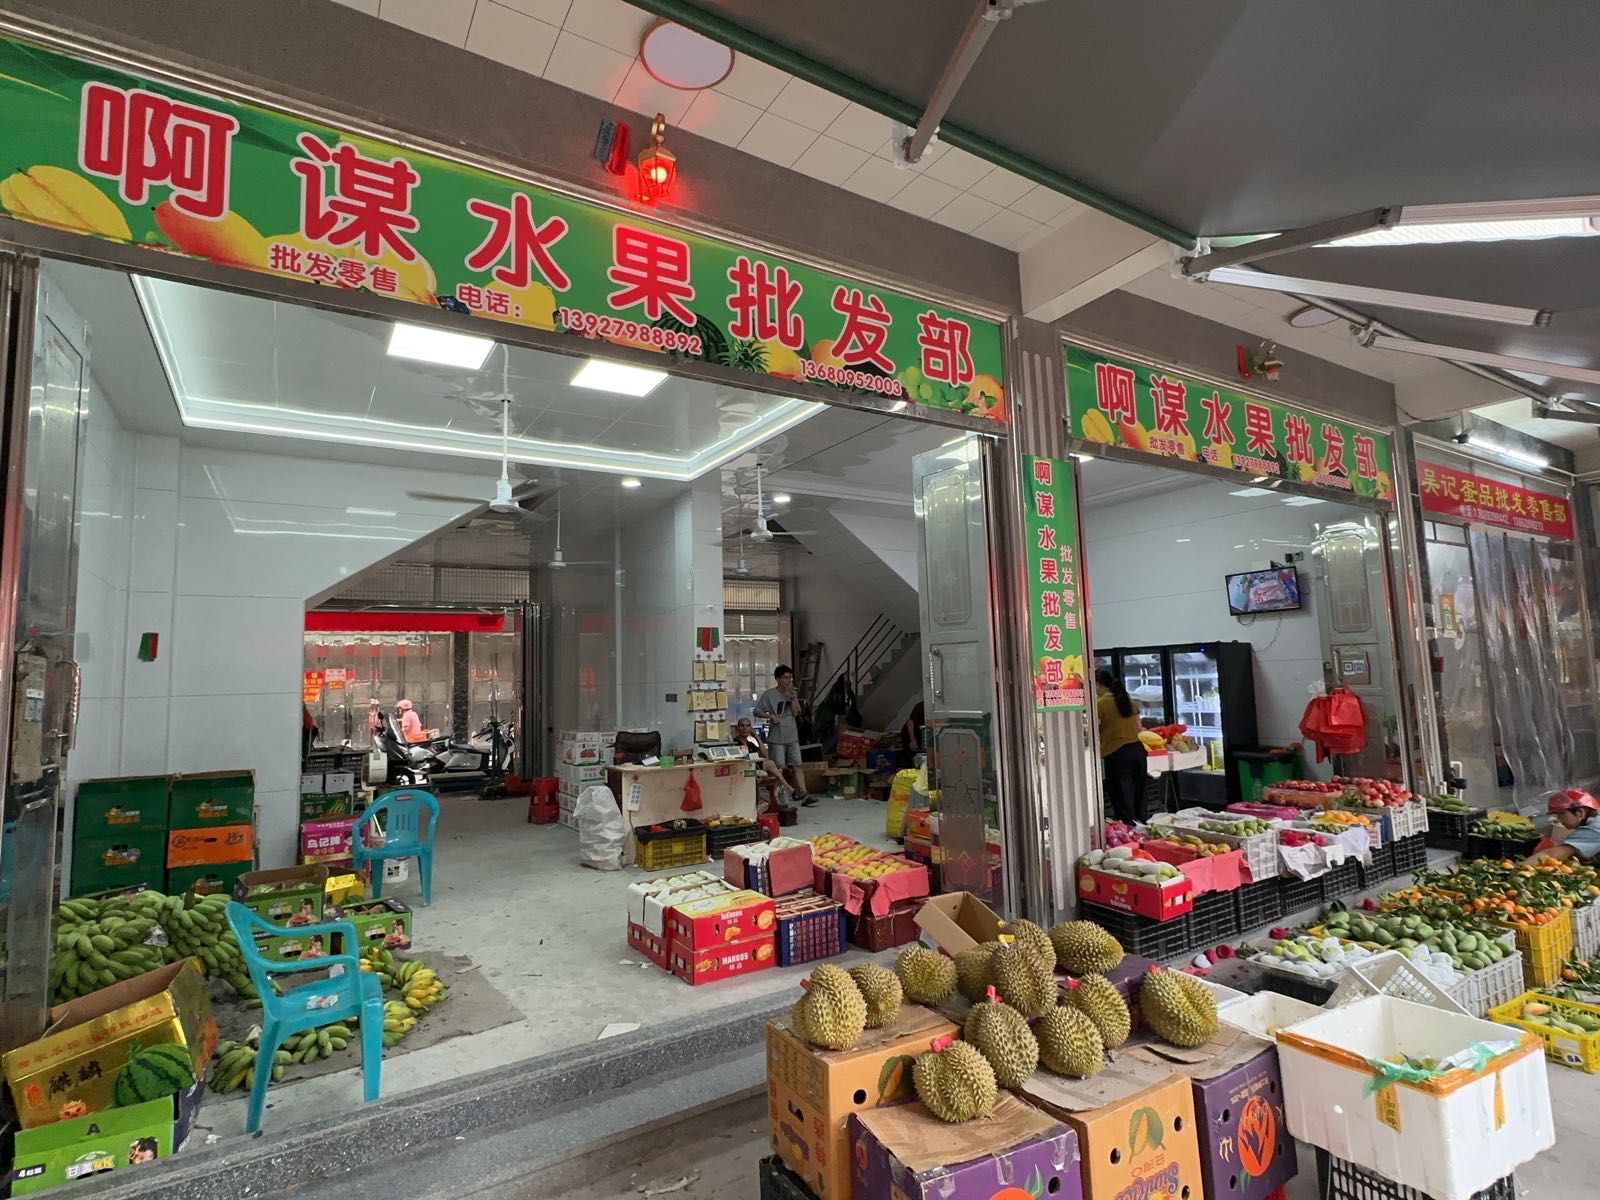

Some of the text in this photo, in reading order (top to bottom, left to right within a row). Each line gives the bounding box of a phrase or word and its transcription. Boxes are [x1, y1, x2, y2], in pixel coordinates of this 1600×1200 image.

[78, 80, 977, 388] 啊谋水果批发部
[269, 243, 400, 294] 批发零售
[559, 306, 703, 356] 13927988892
[800, 358, 903, 396] 13680952003
[1094, 362, 1379, 481] 啊谋水果批发部
[1421, 467, 1567, 525] 吴记蛋品批发零售部
[1034, 460, 1064, 685] 啊谋水果批发部
[1060, 544, 1077, 631] 批发零售
[721, 952, 749, 965] MANGOS
[86, 1123, 101, 1137] A
